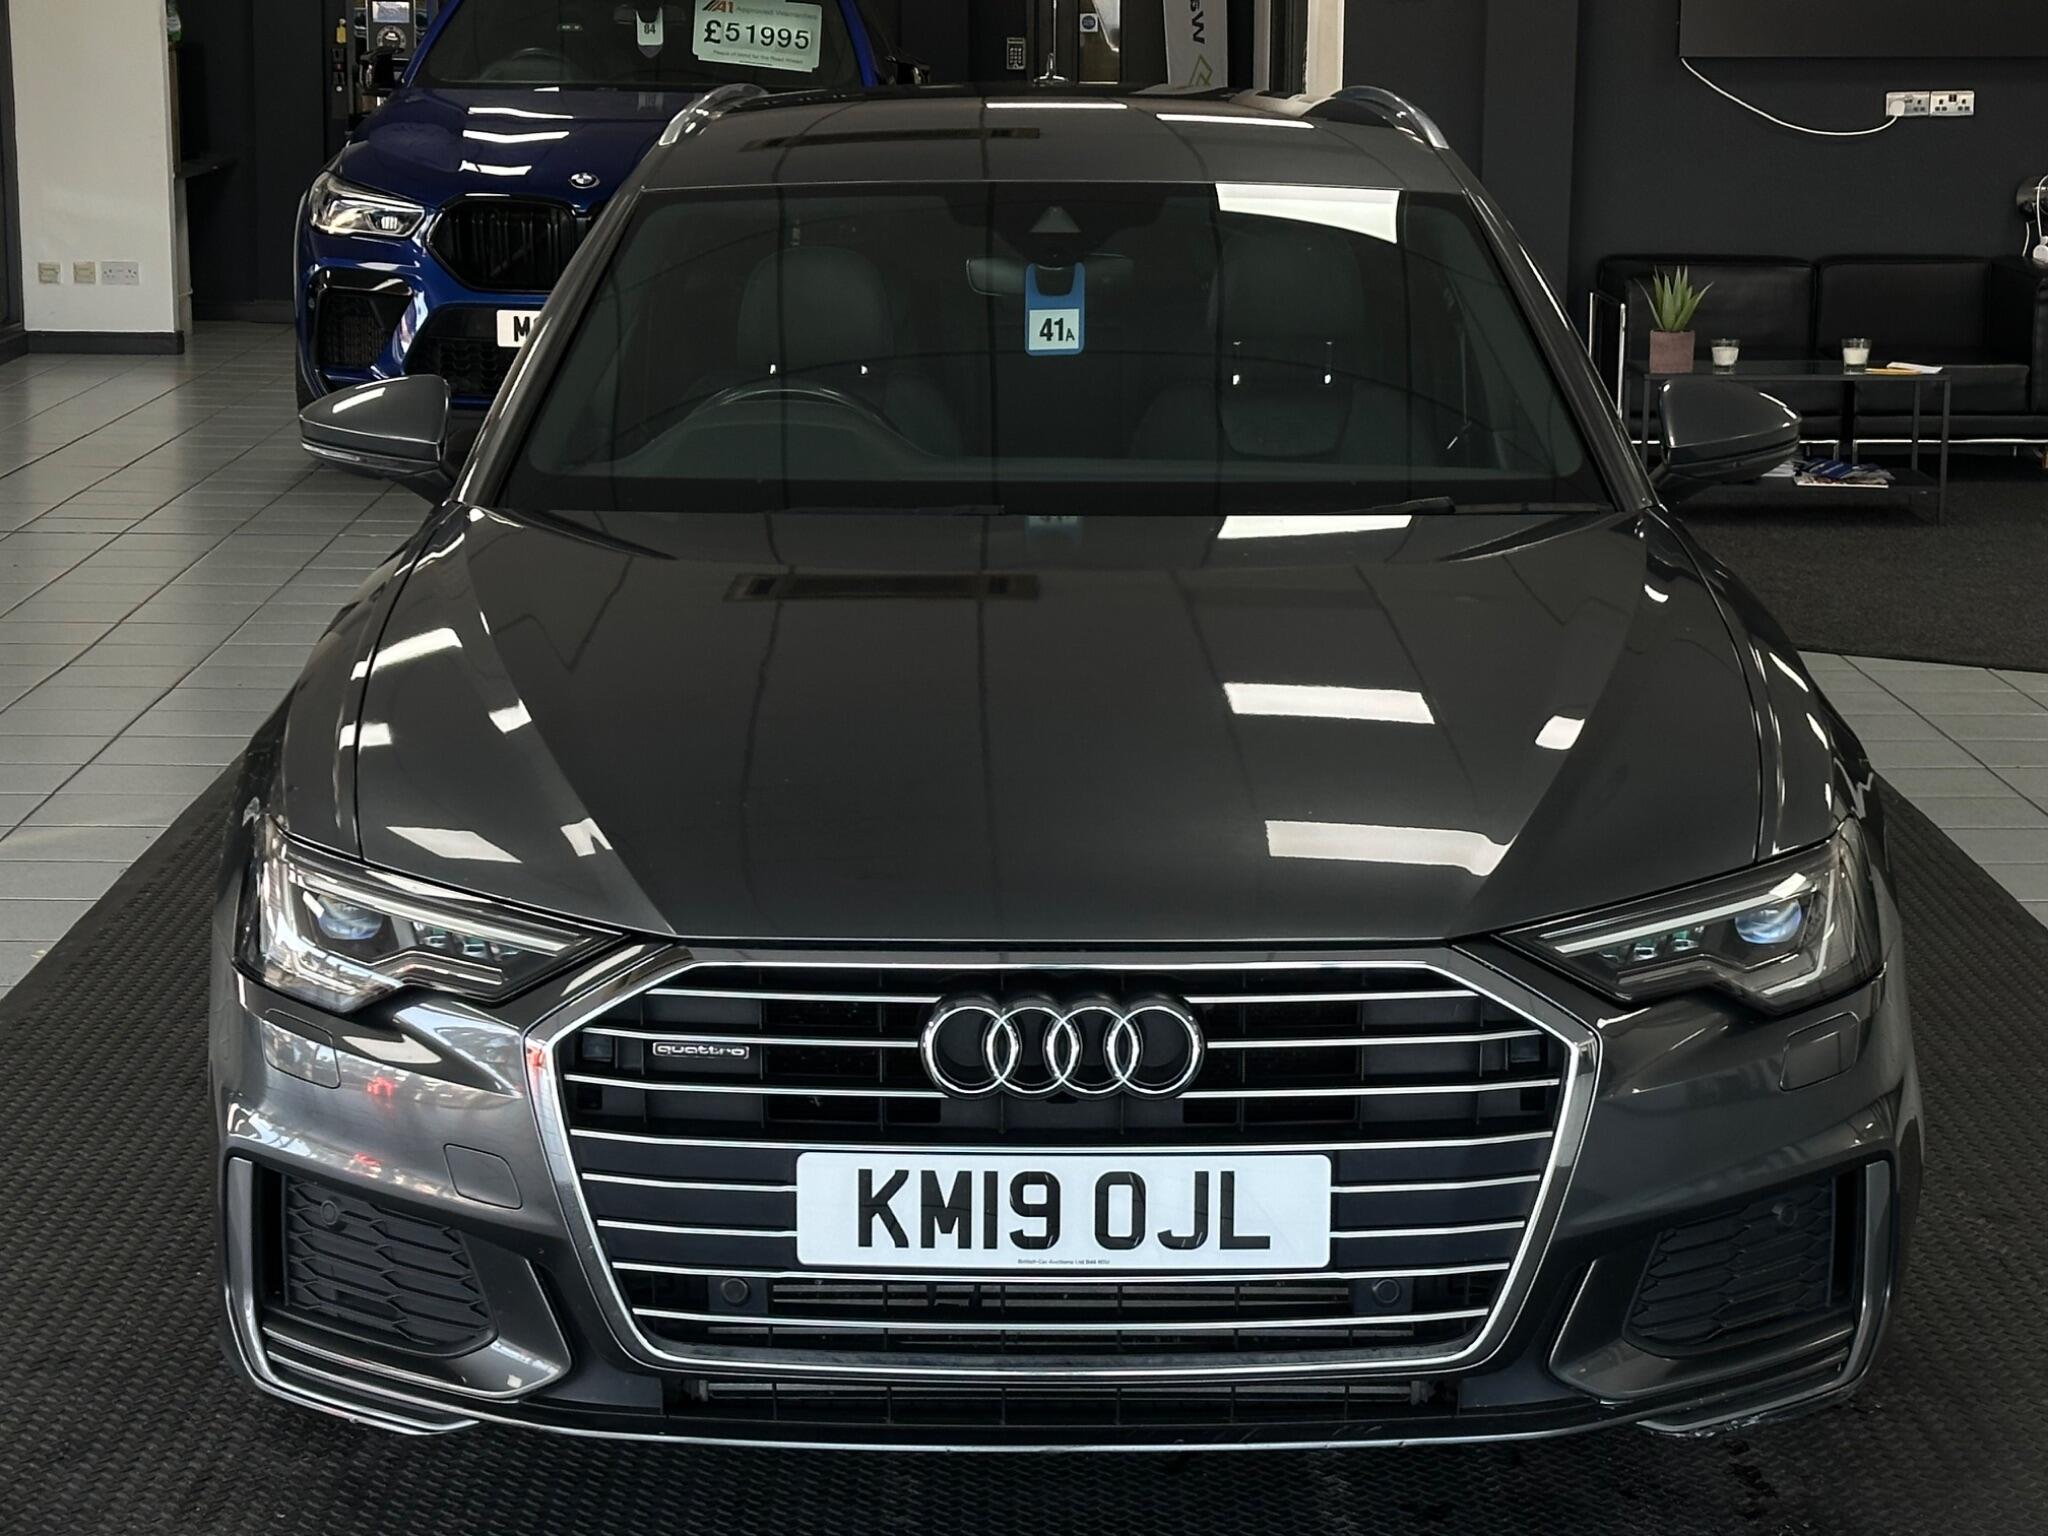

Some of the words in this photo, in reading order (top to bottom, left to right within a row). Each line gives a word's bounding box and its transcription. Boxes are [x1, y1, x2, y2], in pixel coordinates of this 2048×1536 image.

[704, 20, 810, 49] £51995
[657, 1045, 745, 1056] quattro
[858, 1169, 1061, 1250] KM19
[1094, 1171, 1271, 1250] OJL
